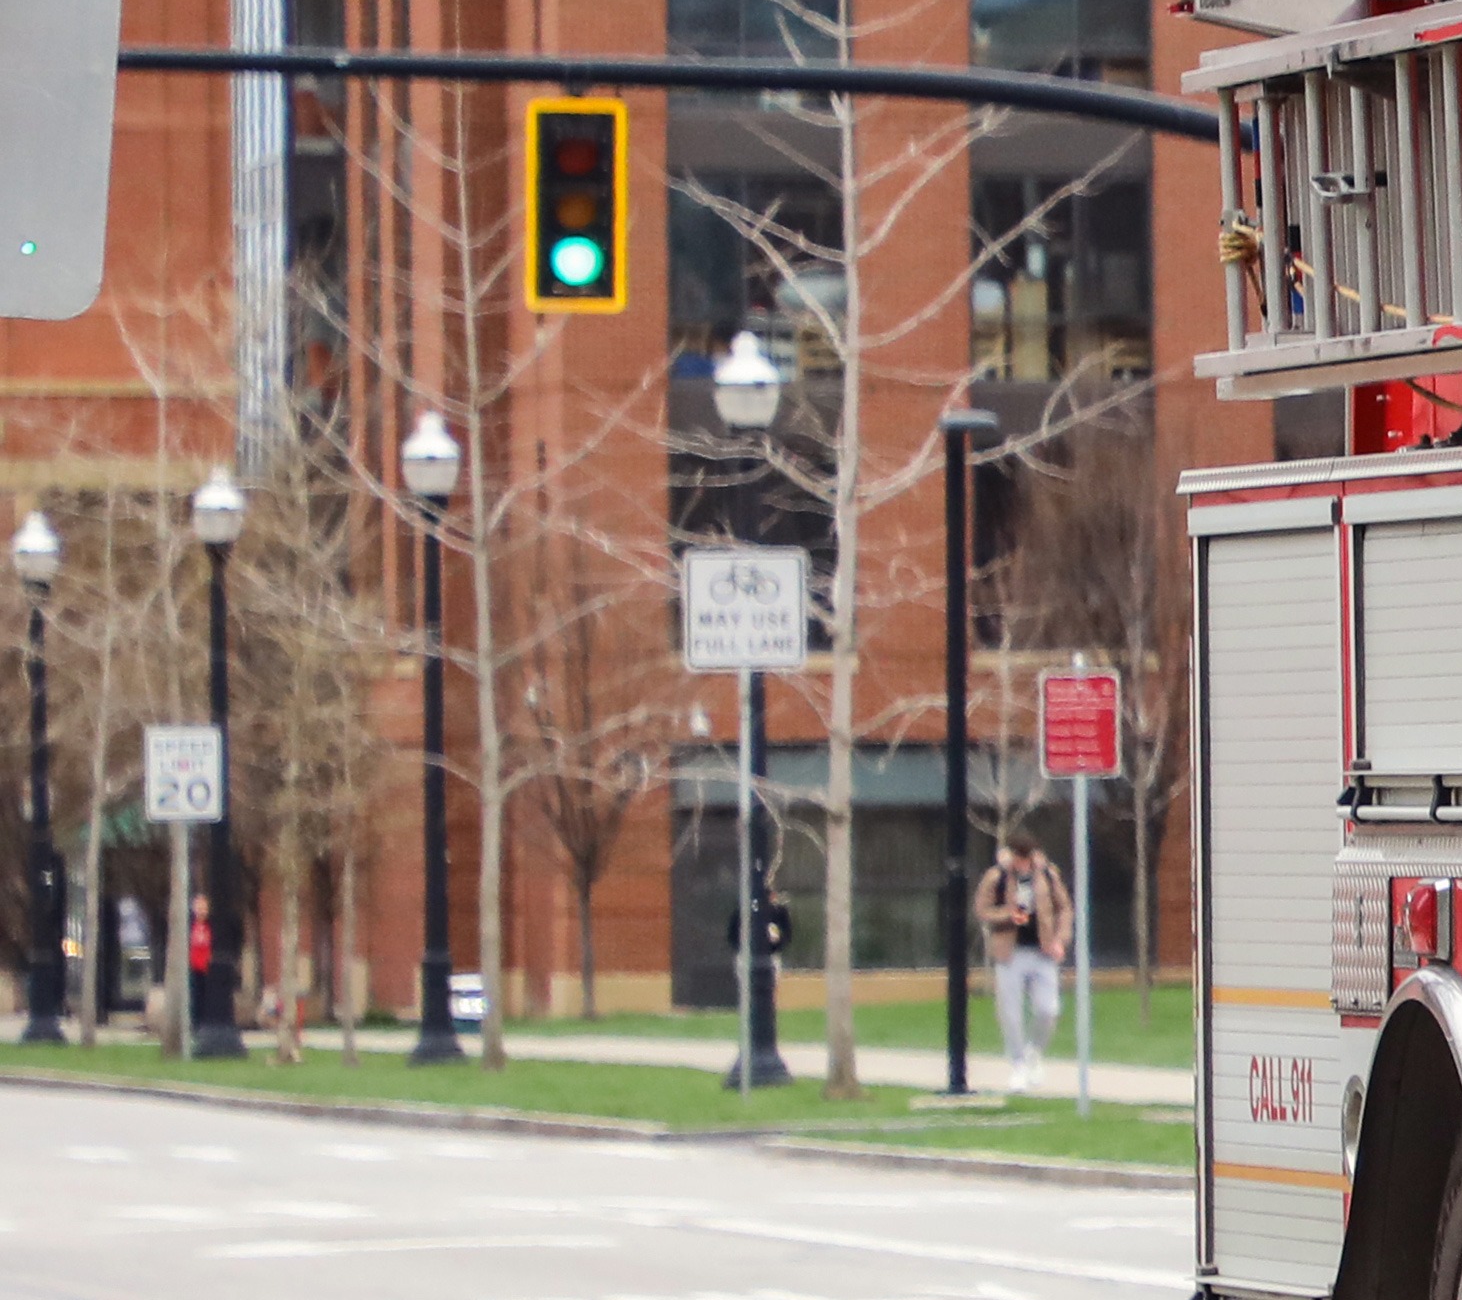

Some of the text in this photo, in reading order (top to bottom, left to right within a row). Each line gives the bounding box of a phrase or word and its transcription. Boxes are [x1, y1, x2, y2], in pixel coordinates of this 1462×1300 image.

[157, 777, 212, 811] 20
[1249, 1055, 1313, 1123] CALL 911
